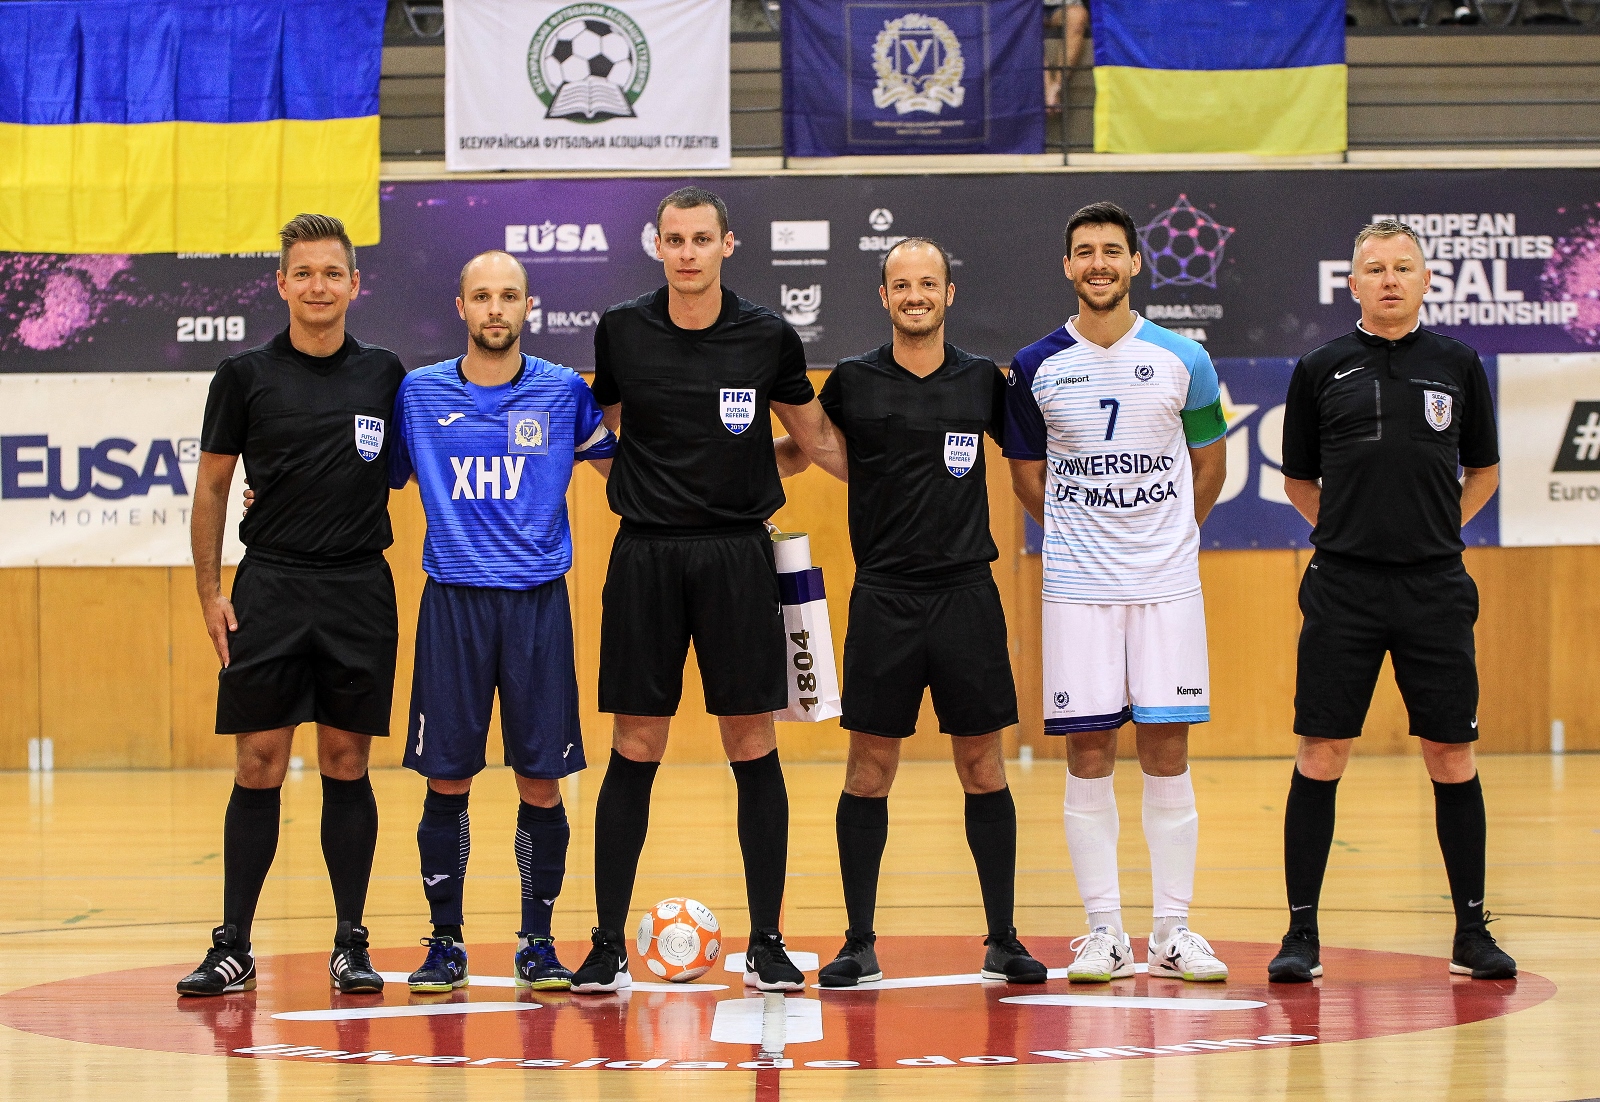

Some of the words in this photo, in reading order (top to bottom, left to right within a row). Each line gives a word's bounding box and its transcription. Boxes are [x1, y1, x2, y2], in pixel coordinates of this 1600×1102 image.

[543, 136, 605, 149] ФУТБОЛЬНА
[1372, 214, 1516, 236] ROPEAN
[505, 222, 609, 252] EUSA
[1318, 259, 1524, 304] FSAL
[177, 316, 245, 342] 2019
[1055, 375, 1090, 386] uhlsport
[723, 392, 752, 403] FIFA
[357, 418, 382, 433] FIFA
[1099, 398, 1120, 441] 7
[947, 435, 975, 448] FIFA
[362, 451, 375, 459] 2019
[1052, 453, 1174, 476] UNIVERSIDAD
[450, 456, 526, 500] ХНУ
[1056, 483, 1080, 502] DE
[1085, 480, 1178, 508] MÁLAGA
[50, 508, 193, 526] MOMENT
[789, 629, 819, 713] 1804
[896, 1055, 1019, 1066] do
[1029, 1033, 1318, 1060] Minho
